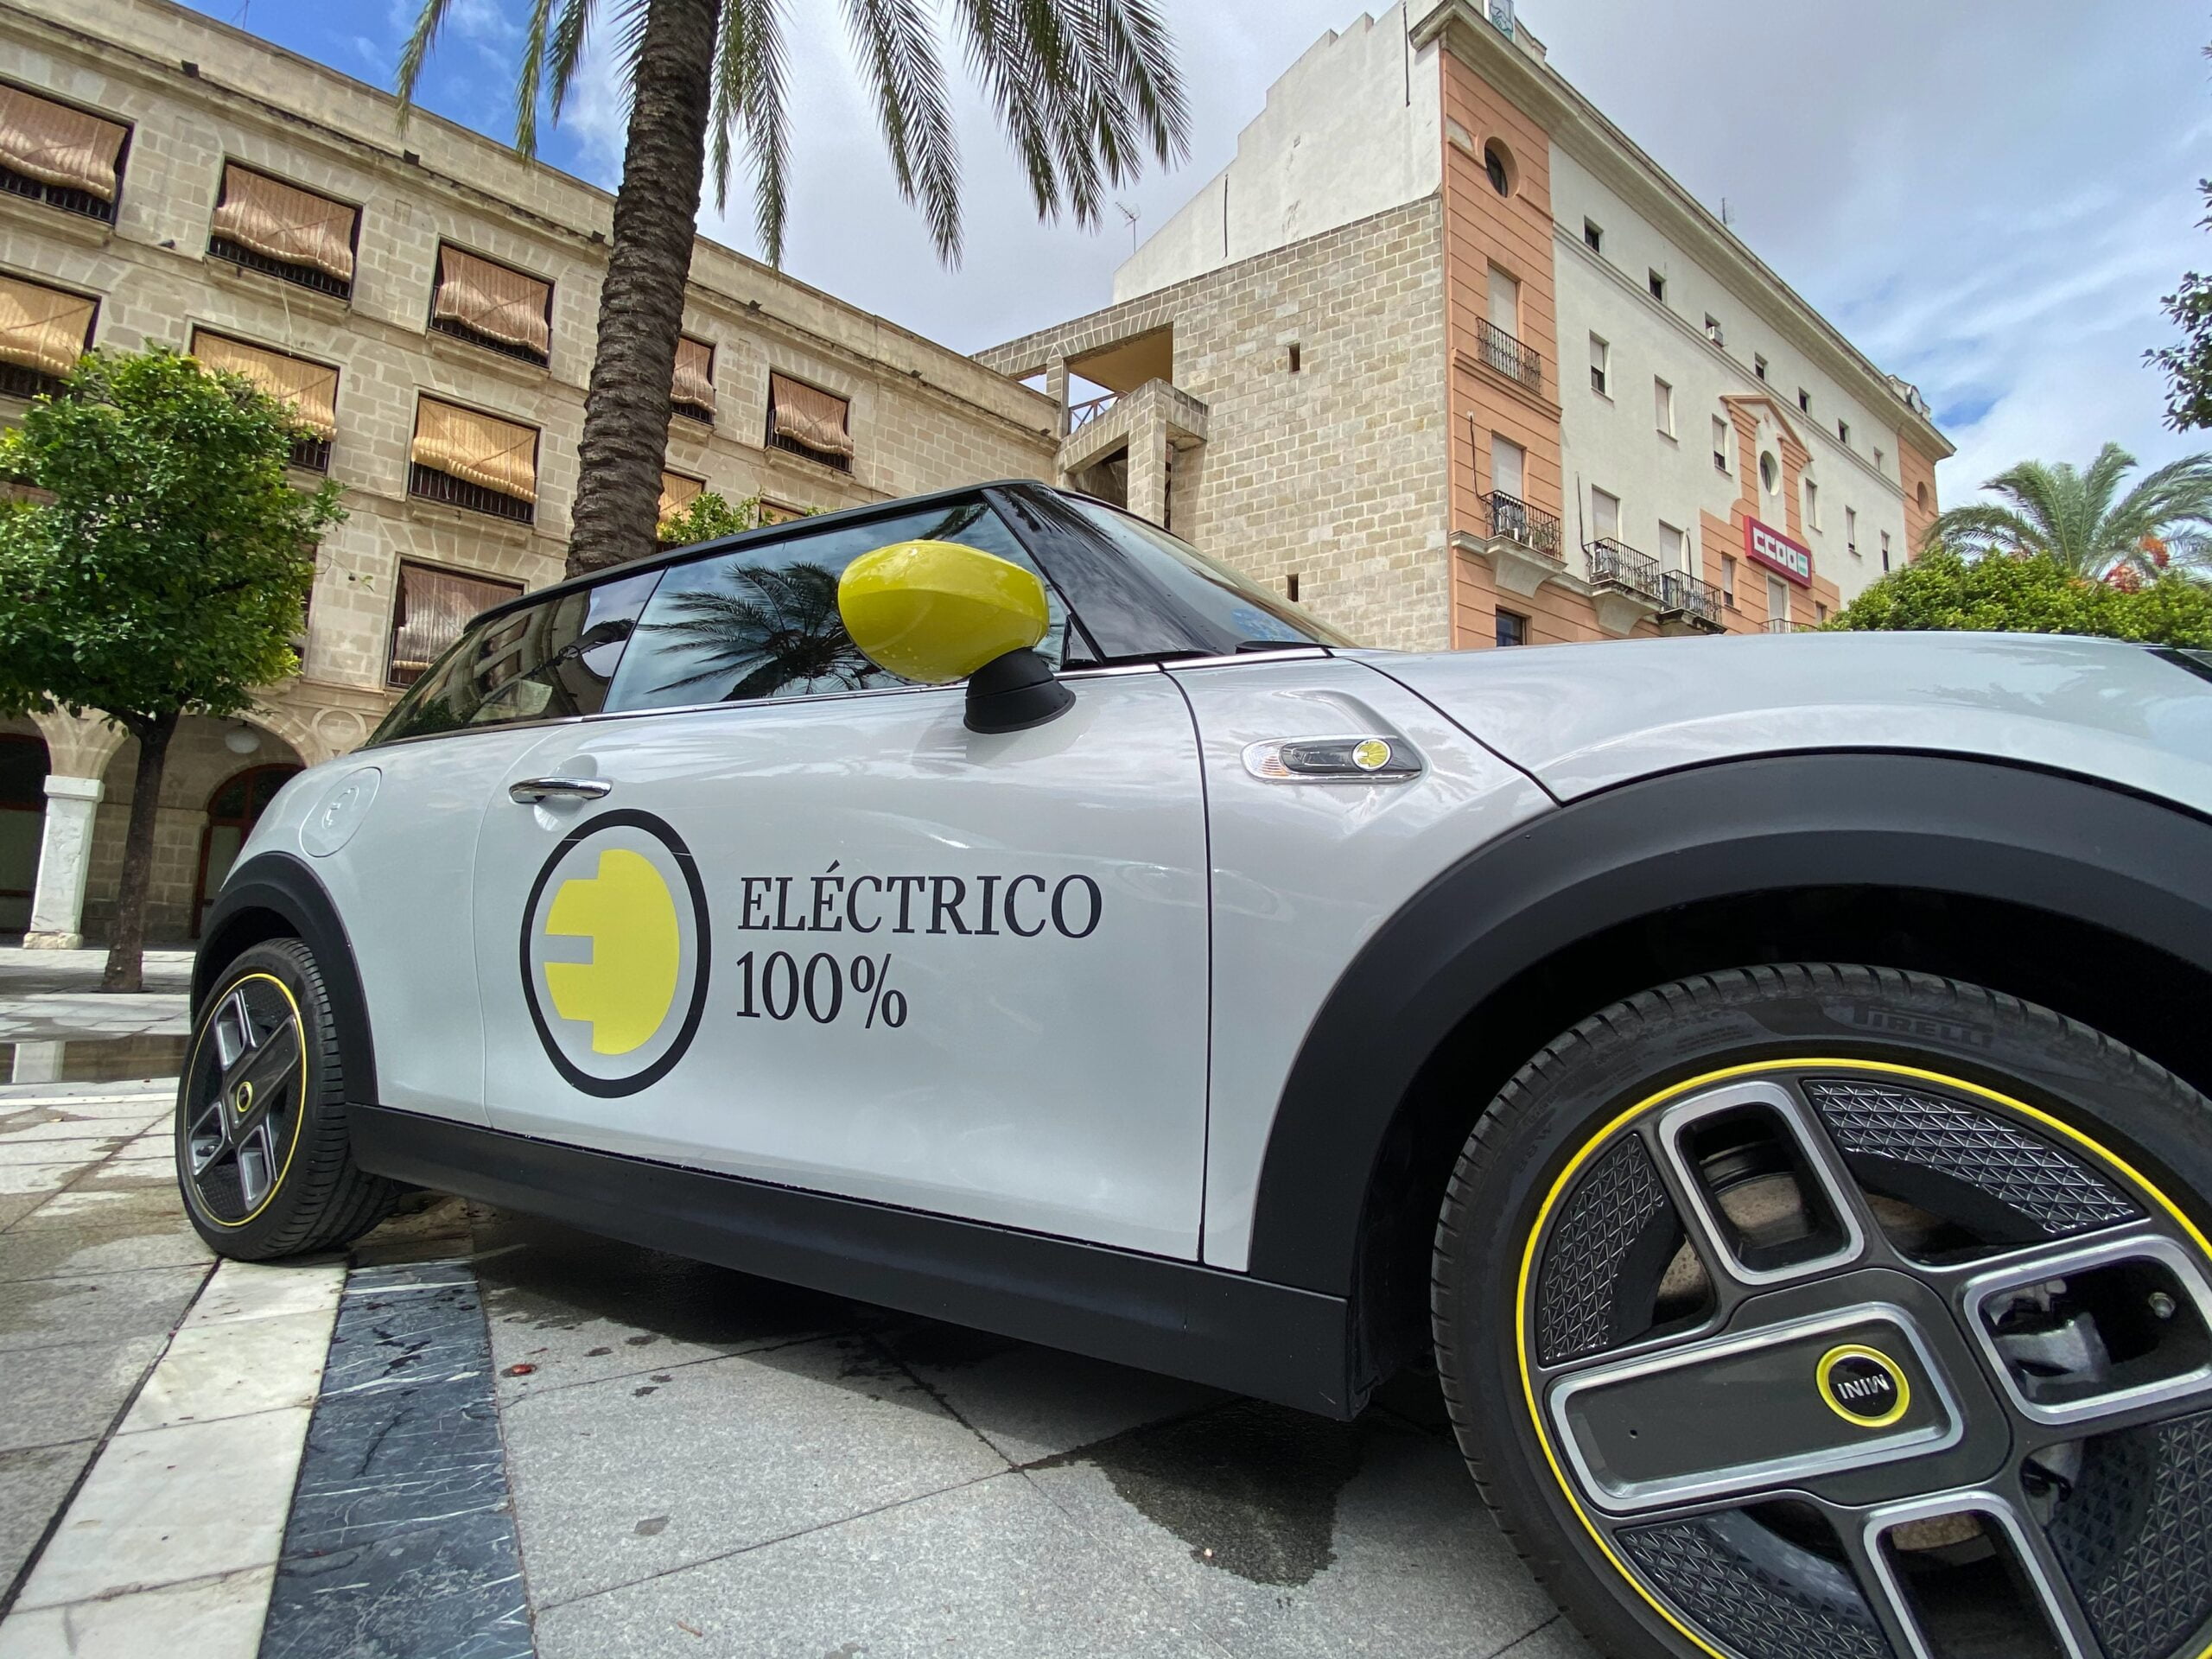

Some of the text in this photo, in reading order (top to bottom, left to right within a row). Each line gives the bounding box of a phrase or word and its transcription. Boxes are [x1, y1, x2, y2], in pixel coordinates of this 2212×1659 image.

[1752, 526, 1798, 573] CCOO
[738, 860, 1103, 938] ELÉCTRICO
[736, 950, 908, 1029] 100%
[1853, 1001, 1993, 1048] PIRELLI
[1837, 1374, 1891, 1399] MINI
